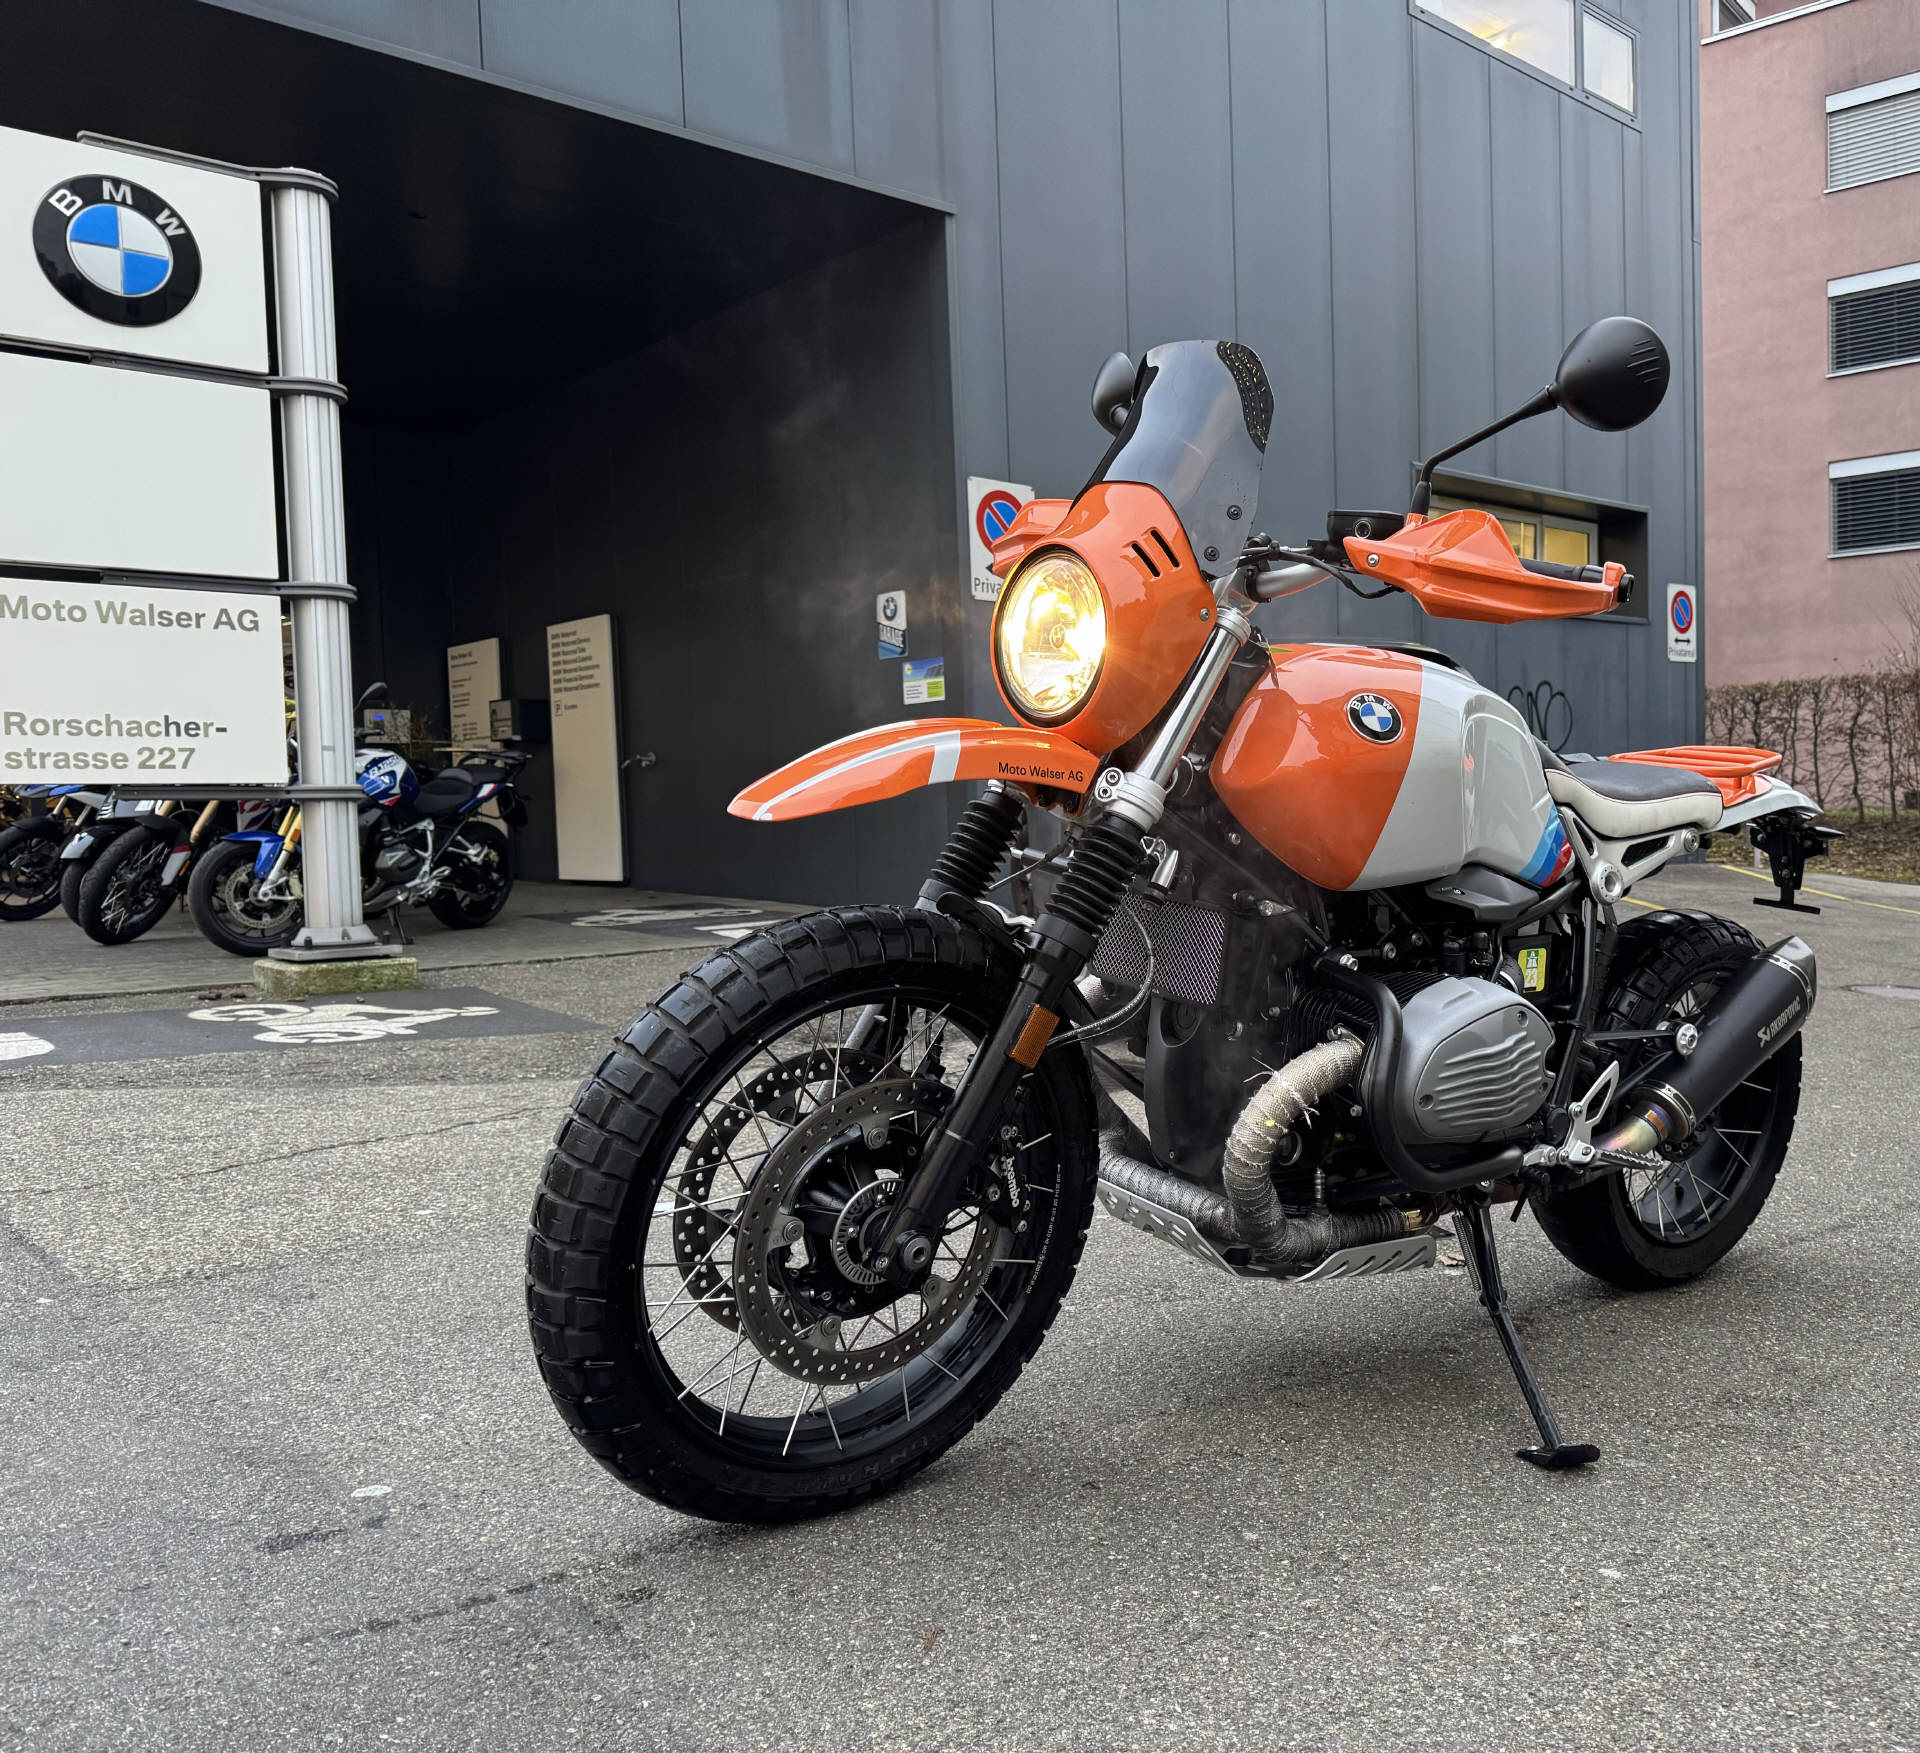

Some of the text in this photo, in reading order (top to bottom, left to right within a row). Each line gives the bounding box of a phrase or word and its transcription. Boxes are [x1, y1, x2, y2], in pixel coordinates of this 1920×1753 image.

[49, 178, 186, 238] BMW
[0, 594, 260, 632] Moto Walser AG
[1351, 695, 1393, 711] BMW
[3, 711, 228, 738] Rorschacher-
[4, 747, 196, 770] strasse 227
[998, 762, 1084, 782] Moto Walser AG
[1007, 1155, 1020, 1208] brembo
